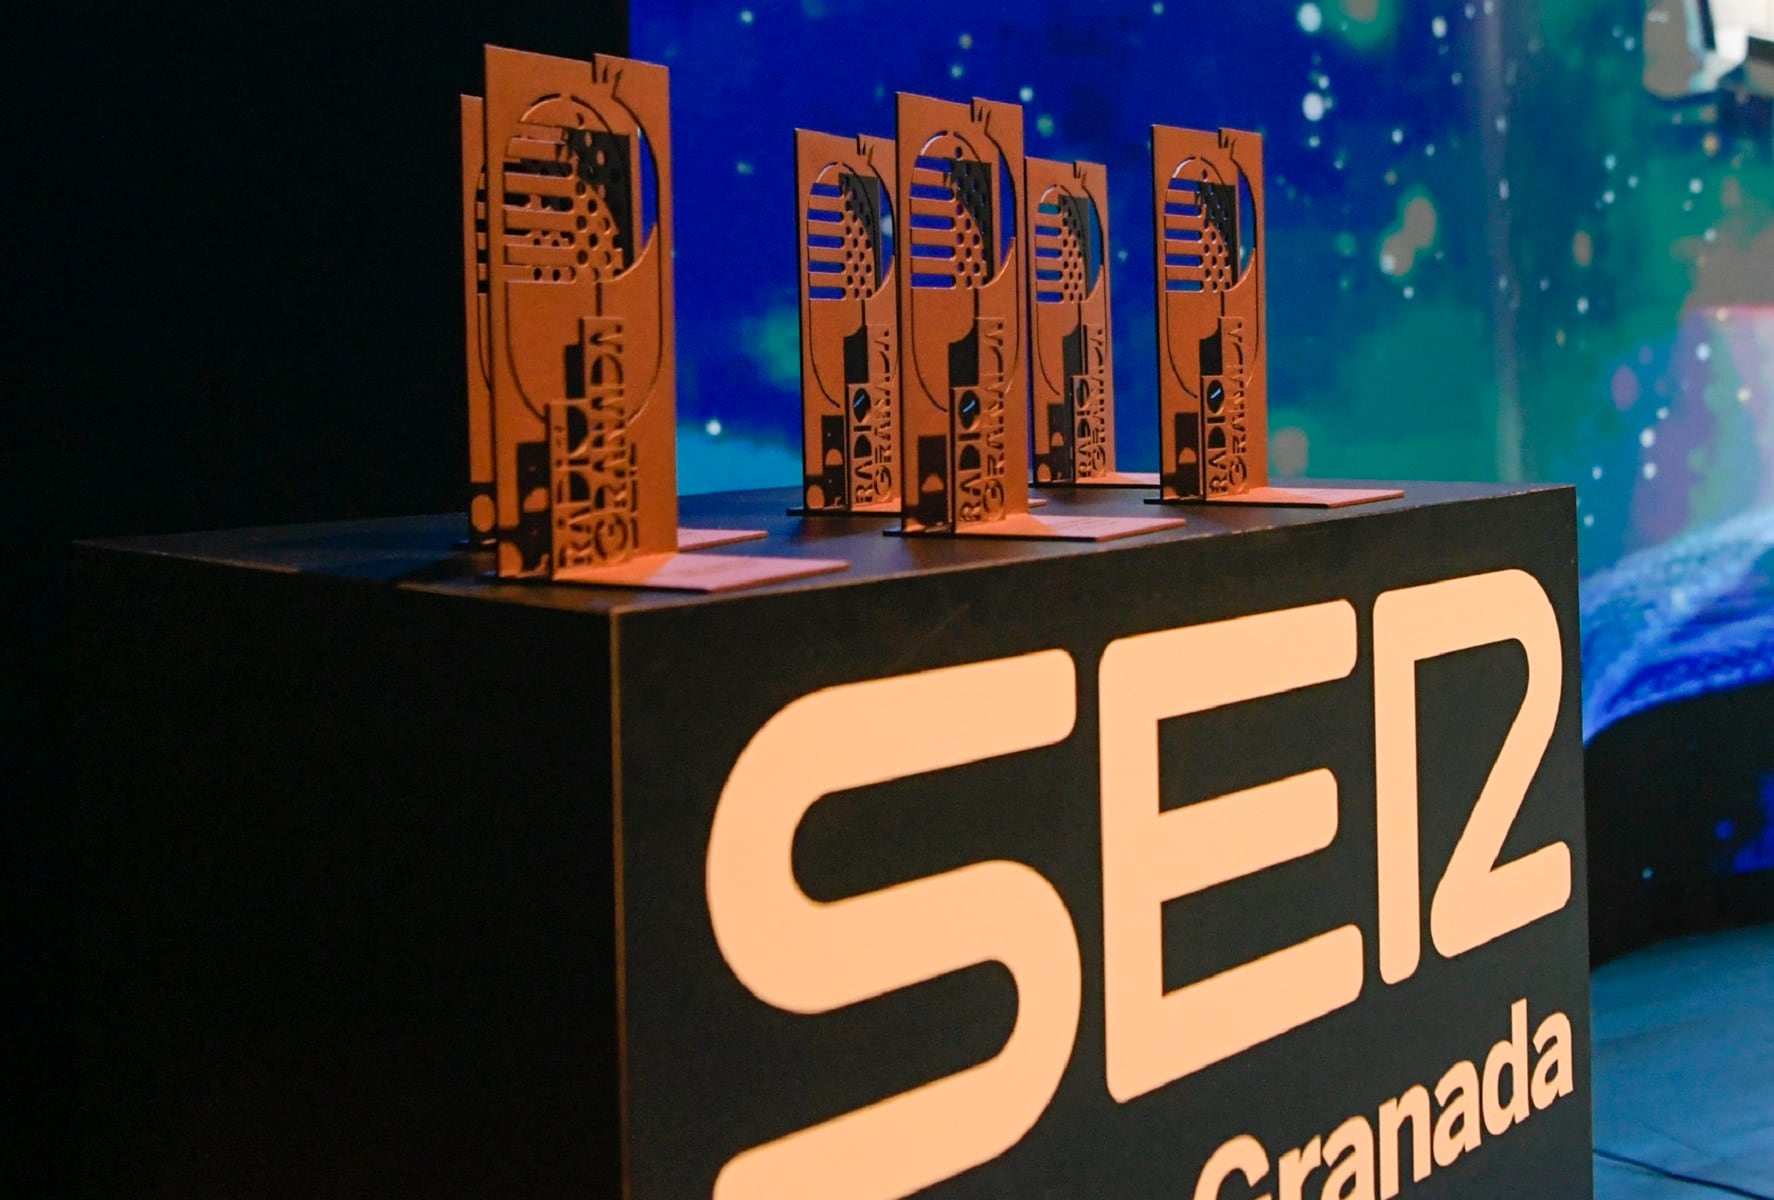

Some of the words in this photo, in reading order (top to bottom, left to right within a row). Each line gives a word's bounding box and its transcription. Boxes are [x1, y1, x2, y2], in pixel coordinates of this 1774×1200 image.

[557, 404, 591, 567] RADIO
[590, 322, 628, 561] GRANADA
[852, 386, 873, 504] RADIO
[873, 328, 892, 501] GRANADA
[957, 389, 981, 521] RADIO
[981, 321, 1004, 519] GRANADA
[1076, 377, 1092, 478] RADIO
[1206, 379, 1227, 493] RADIO
[1227, 321, 1248, 491] GRANADA
[705, 568, 1572, 1200] SER
